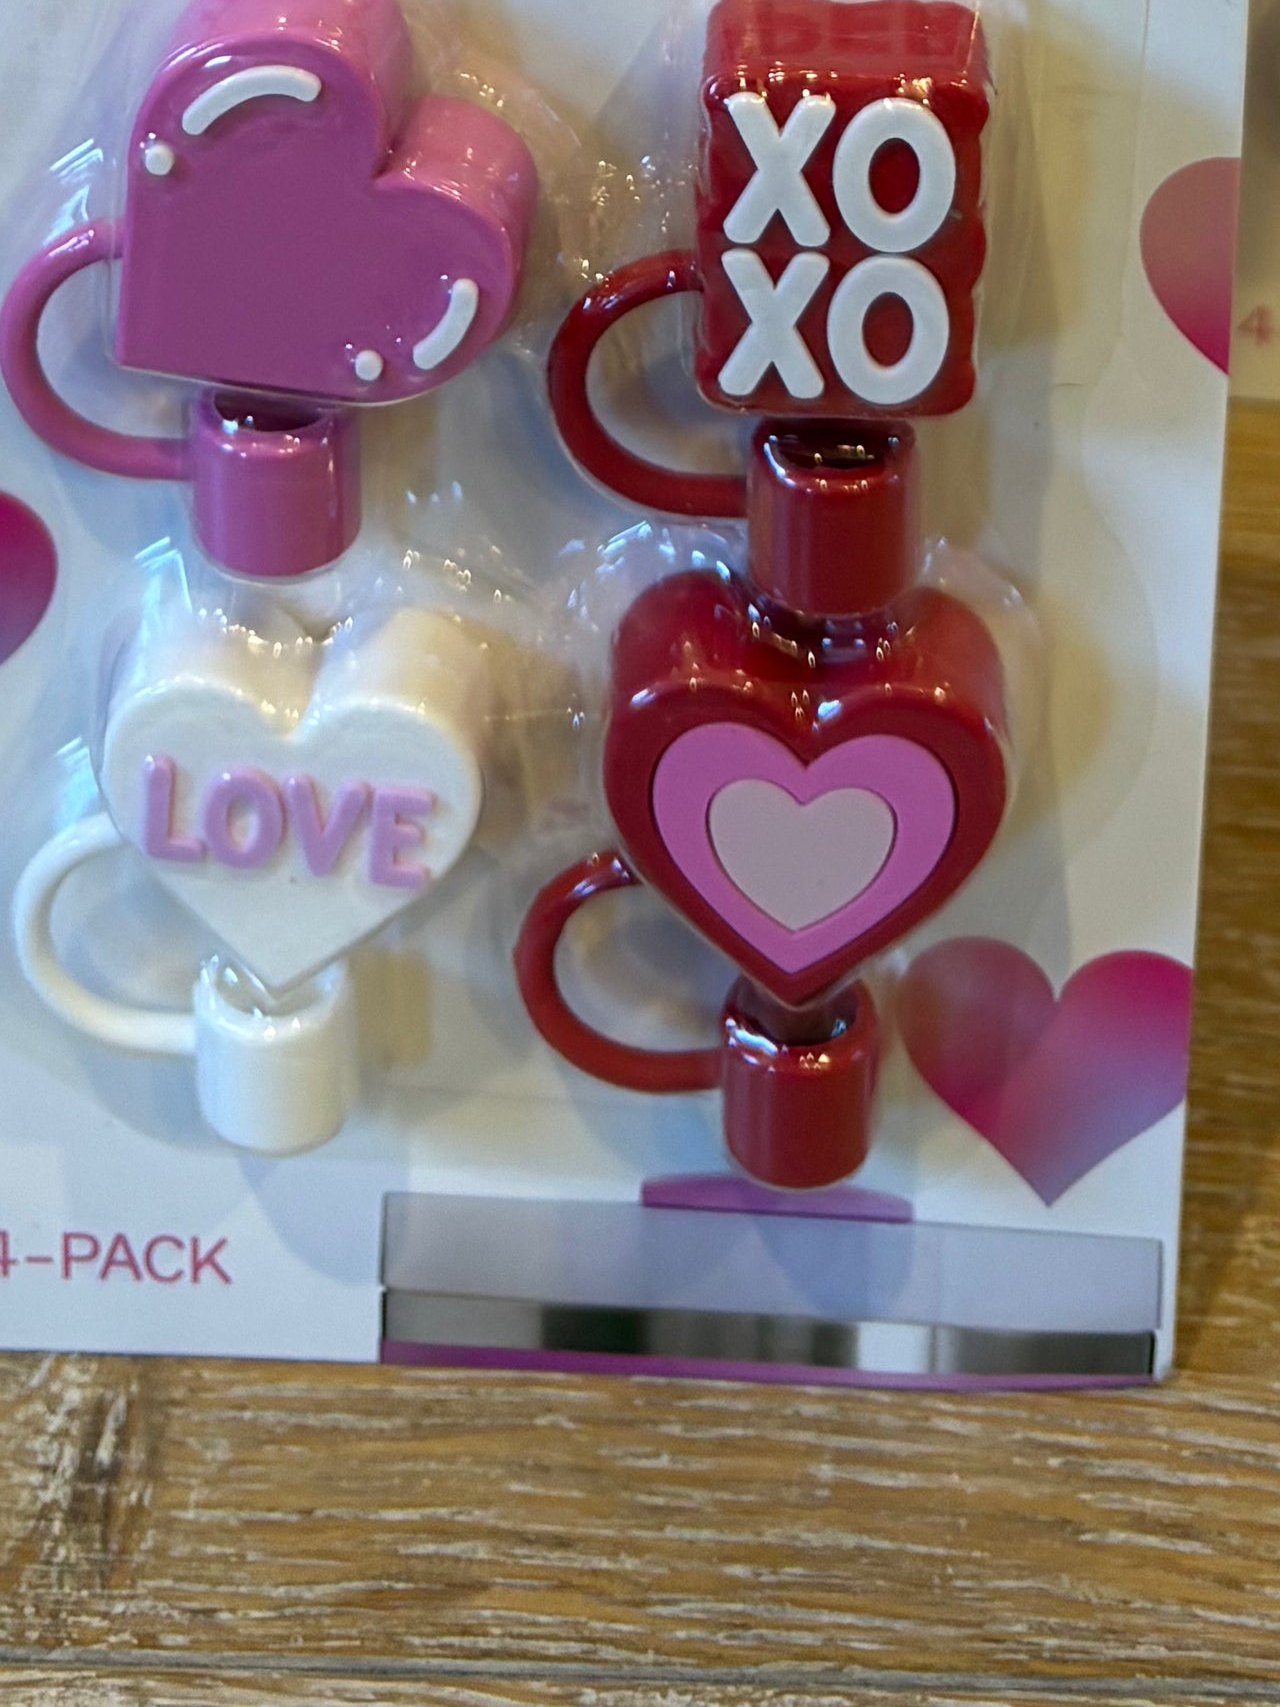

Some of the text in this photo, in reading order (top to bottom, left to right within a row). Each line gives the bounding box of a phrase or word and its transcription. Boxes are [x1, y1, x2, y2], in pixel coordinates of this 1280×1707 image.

[722, 90, 957, 254] XO
[717, 247, 950, 406] XO
[142, 752, 439, 889] LOVE
